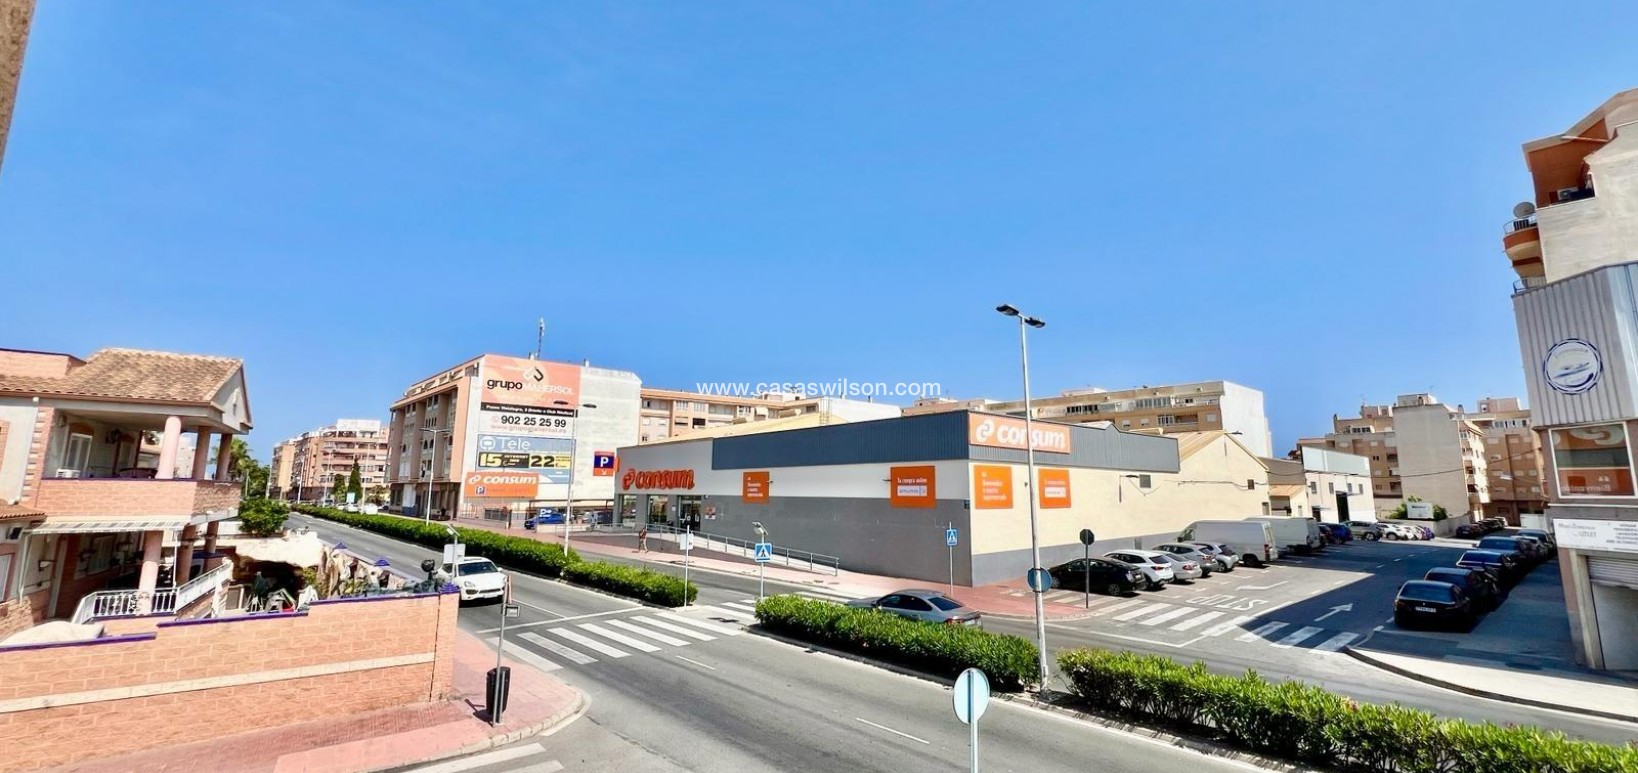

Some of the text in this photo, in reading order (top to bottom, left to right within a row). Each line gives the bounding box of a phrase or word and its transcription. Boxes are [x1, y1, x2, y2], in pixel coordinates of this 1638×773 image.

[487, 380, 523, 390] grupo
[501, 415, 567, 428] 902 25 25 99
[499, 437, 531, 450] Tele
[479, 453, 503, 467] 15
[530, 455, 555, 468] 22
[601, 457, 609, 468] P
[483, 476, 537, 485] consum
[635, 470, 695, 490] consum
